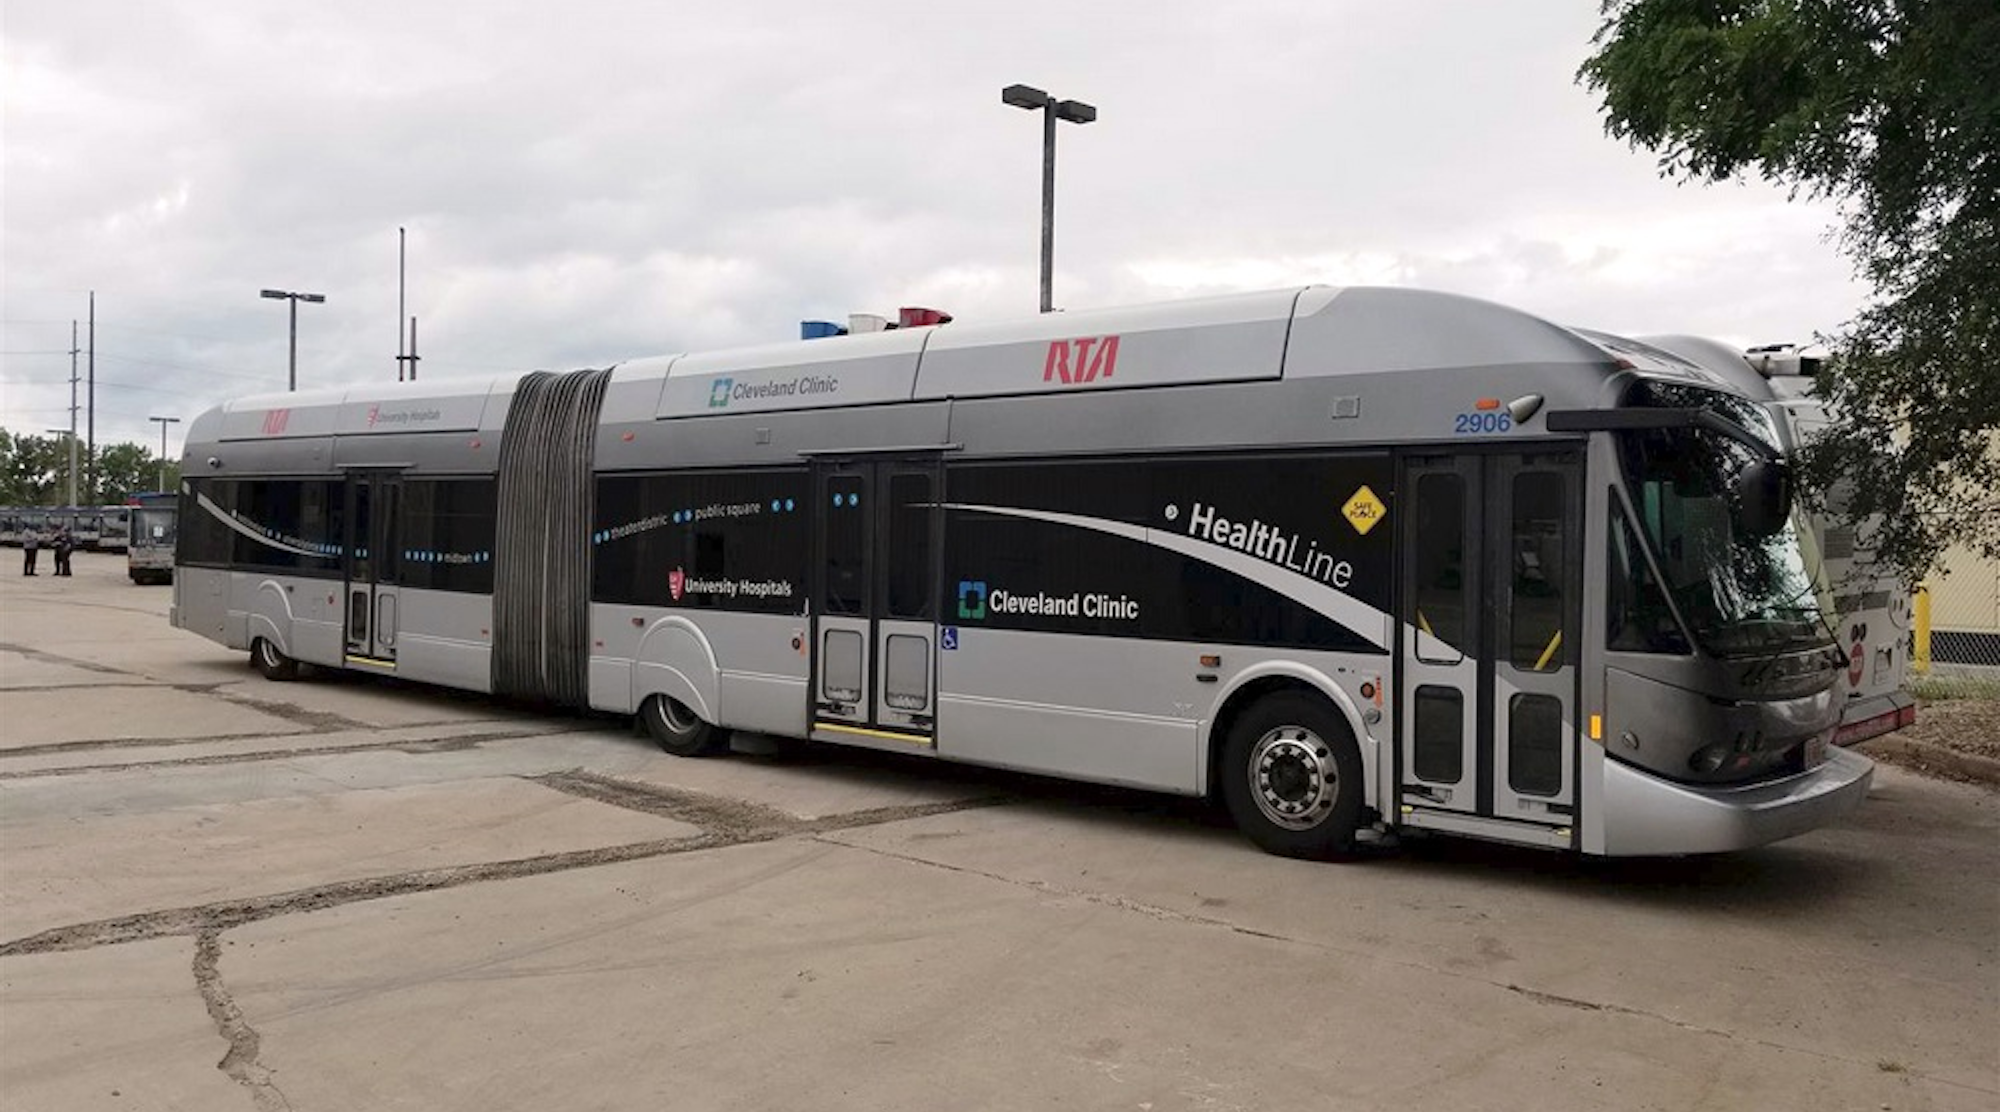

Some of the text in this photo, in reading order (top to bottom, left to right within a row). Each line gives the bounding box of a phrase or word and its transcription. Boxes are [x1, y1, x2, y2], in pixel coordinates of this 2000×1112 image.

[1043, 336, 1120, 383] RTA
[732, 375, 838, 401] Cleveland Clinic
[1454, 412, 1512, 434] 2906
[694, 502, 762, 522] public square
[1188, 502, 1354, 590] HealthLine
[685, 577, 792, 599] University Hospitals
[989, 588, 1139, 620] Cleveland Clinic
